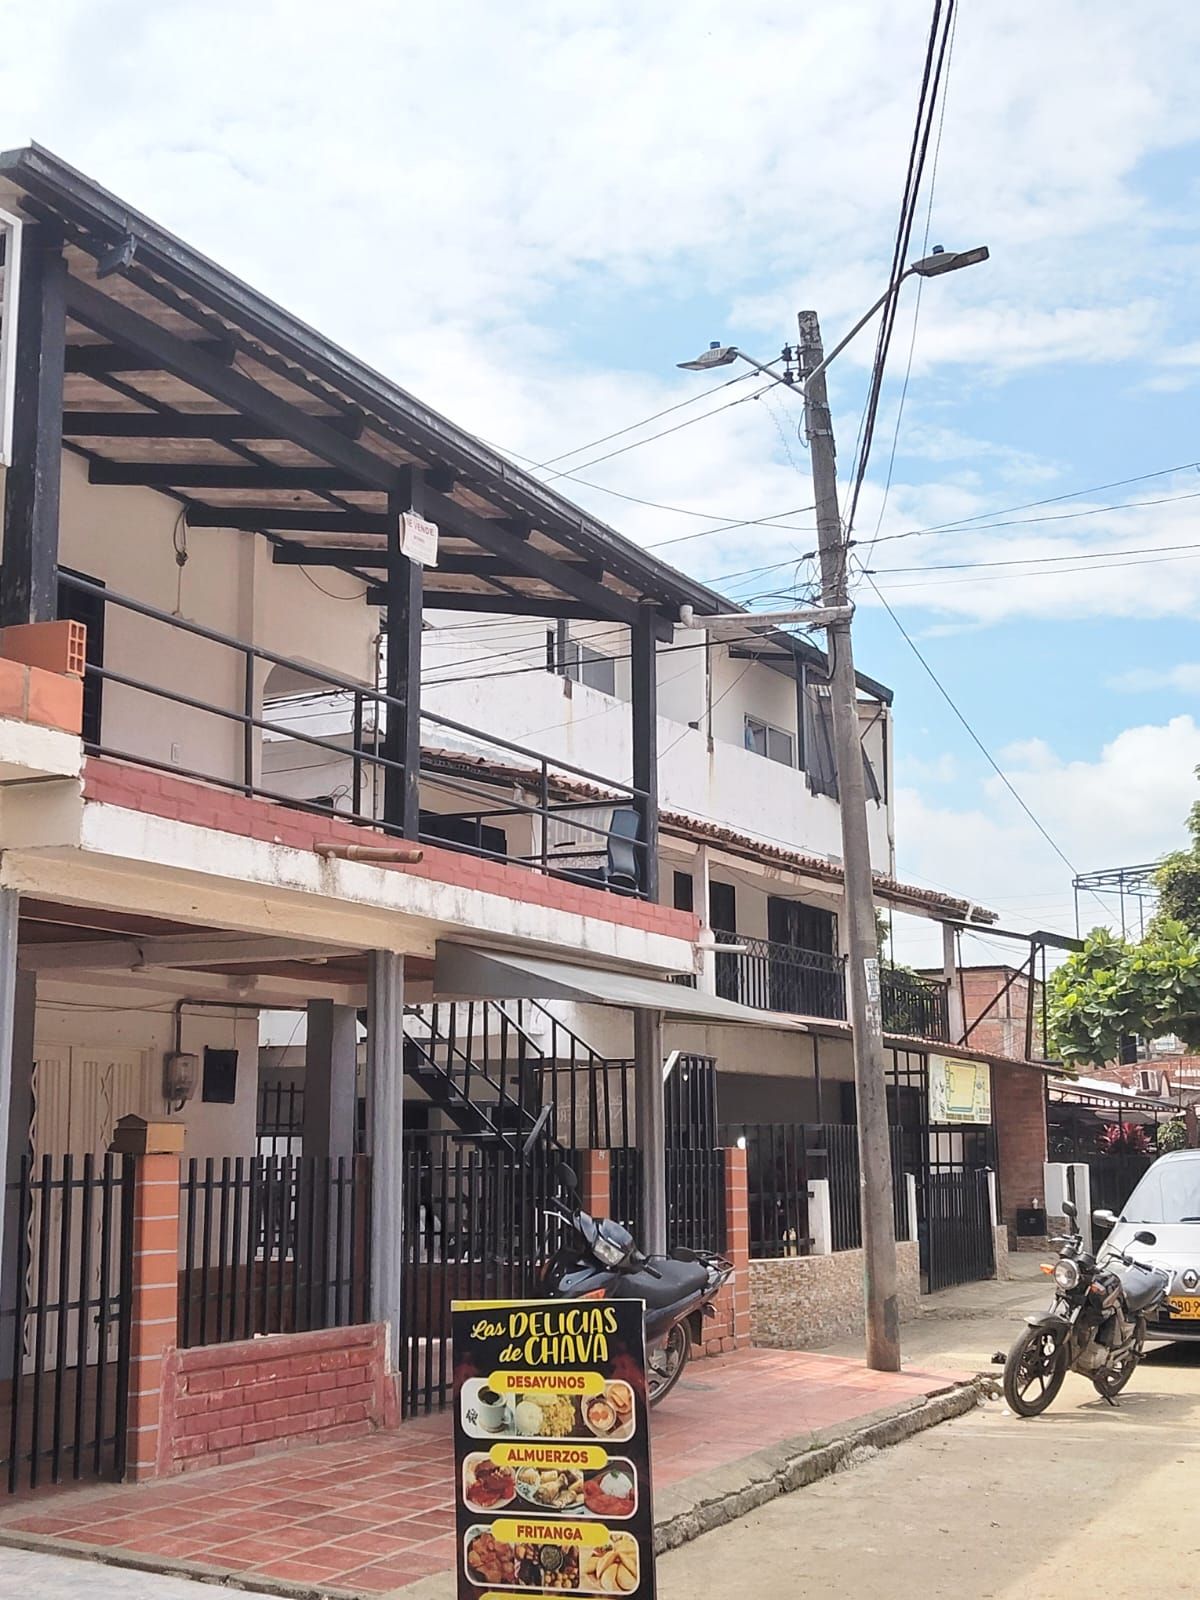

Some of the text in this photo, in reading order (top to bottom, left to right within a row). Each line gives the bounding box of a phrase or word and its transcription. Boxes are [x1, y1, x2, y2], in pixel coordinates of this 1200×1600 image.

[414, 522, 435, 536] VENDE
[470, 1307, 618, 1341] Las DELICIAS
[498, 1333, 609, 1366] de CHAVA
[506, 1374, 586, 1389] DESAYUNOS
[507, 1448, 589, 1464] ALMUERZOS
[516, 1524, 584, 1541] FRITANGA
